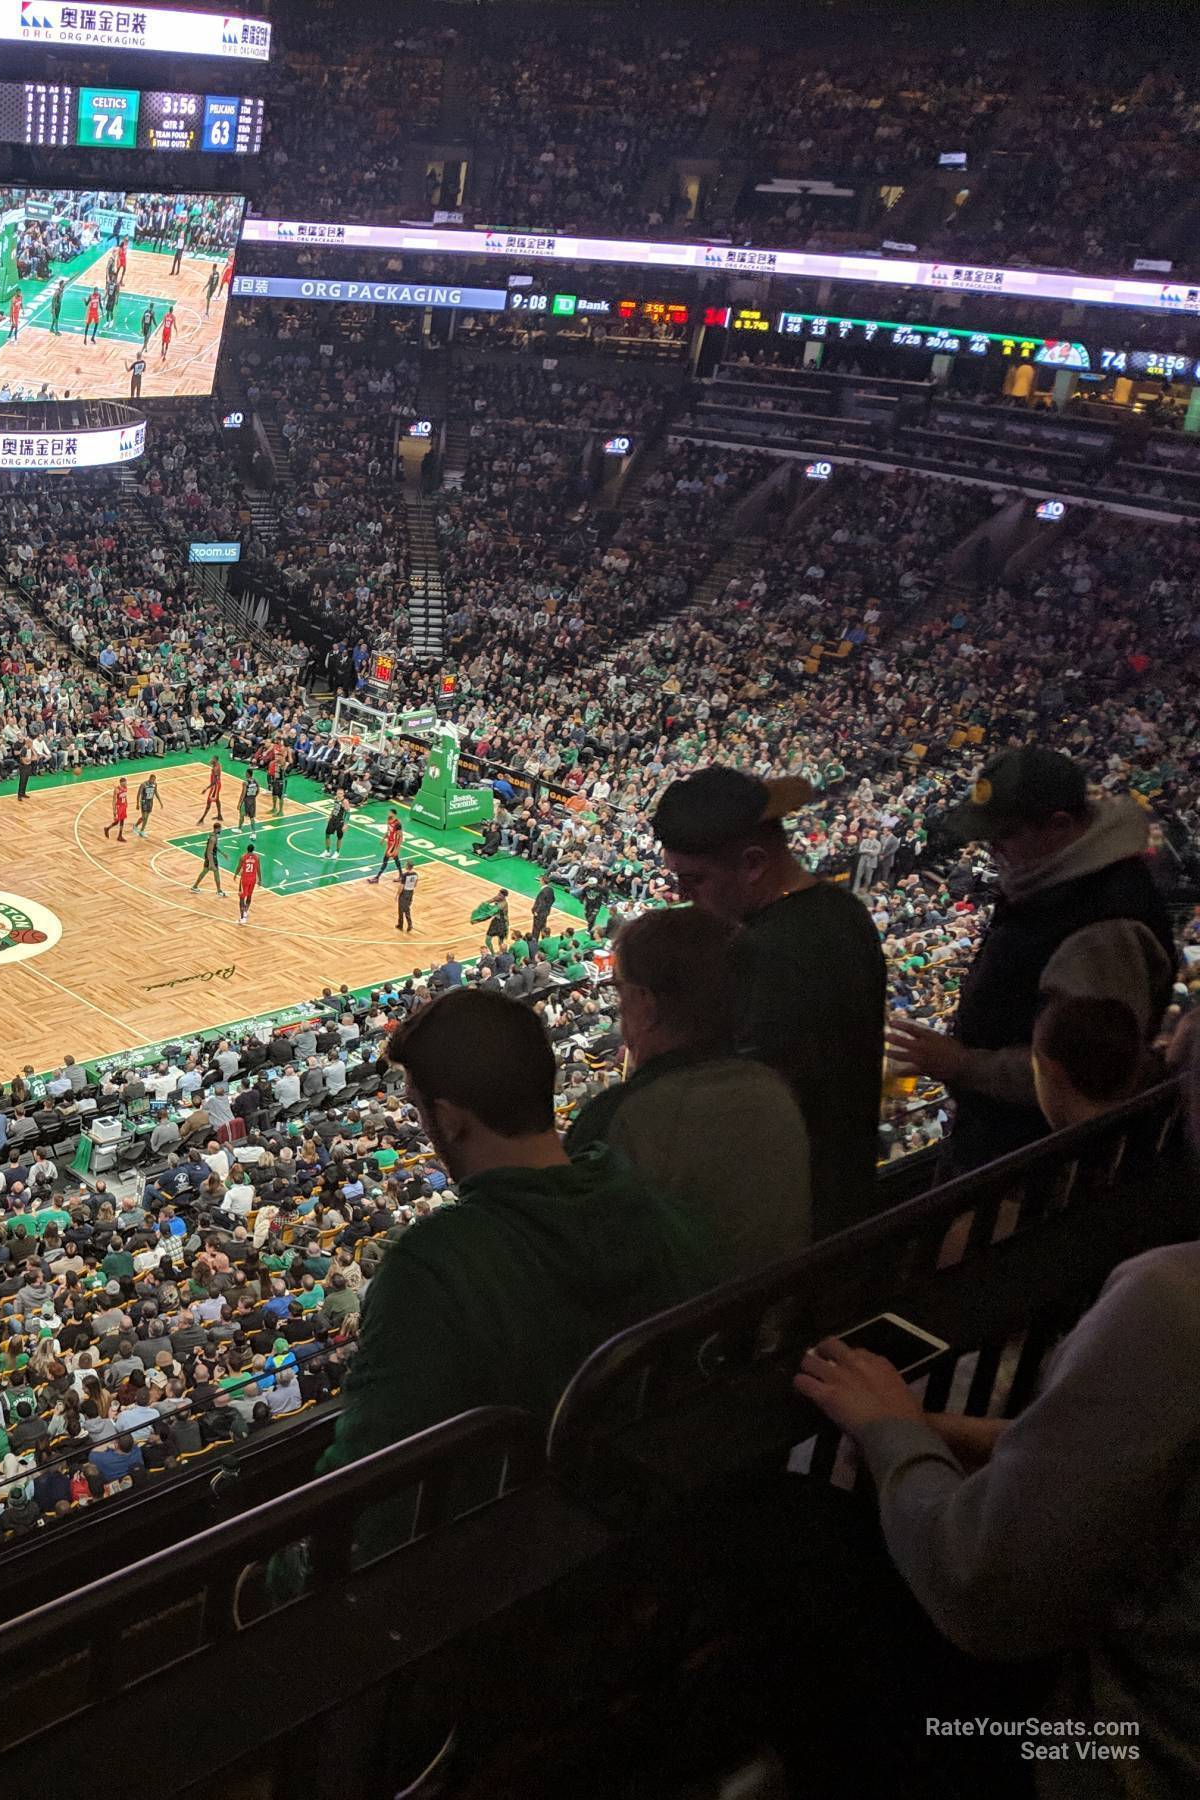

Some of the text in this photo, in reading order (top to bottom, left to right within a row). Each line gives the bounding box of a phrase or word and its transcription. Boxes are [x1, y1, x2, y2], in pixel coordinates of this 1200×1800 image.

[60, 7, 147, 35] 奥瑞金包装
[59, 32, 146, 47] ORG PACKAGING
[92, 97, 127, 109] CELTICS
[162, 97, 196, 114] 3:56
[209, 104, 235, 115] PELICANS
[93, 114, 124, 140] 74
[163, 120, 177, 130] QTR
[156, 131, 188, 139] TEAM FOULS
[211, 120, 230, 145] 63
[301, 281, 461, 304] ORG PACKAGING
[512, 294, 547, 310] 9:08
[578, 299, 610, 312] Bank
[645, 303, 664, 313] 3:56
[786, 323, 921, 345] 36 13 7 7 5/28
[1102, 351, 1127, 369] 74
[1146, 353, 1185, 370] 3:56
[230, 412, 243, 424] 10
[417, 421, 431, 433] 10
[2, 437, 79, 456] 奥瑞金包装
[613, 437, 629, 449] 10
[1, 457, 77, 466] ORG PACKAGING
[815, 462, 832, 475] 10
[1047, 501, 1064, 516] 10
[497, 772, 531, 790] GRDEN
[449, 800, 479, 810] Scientific
[350, 813, 480, 867] GADEN
[245, 863, 254, 873] 21
[34, 1085, 47, 1097] 42
